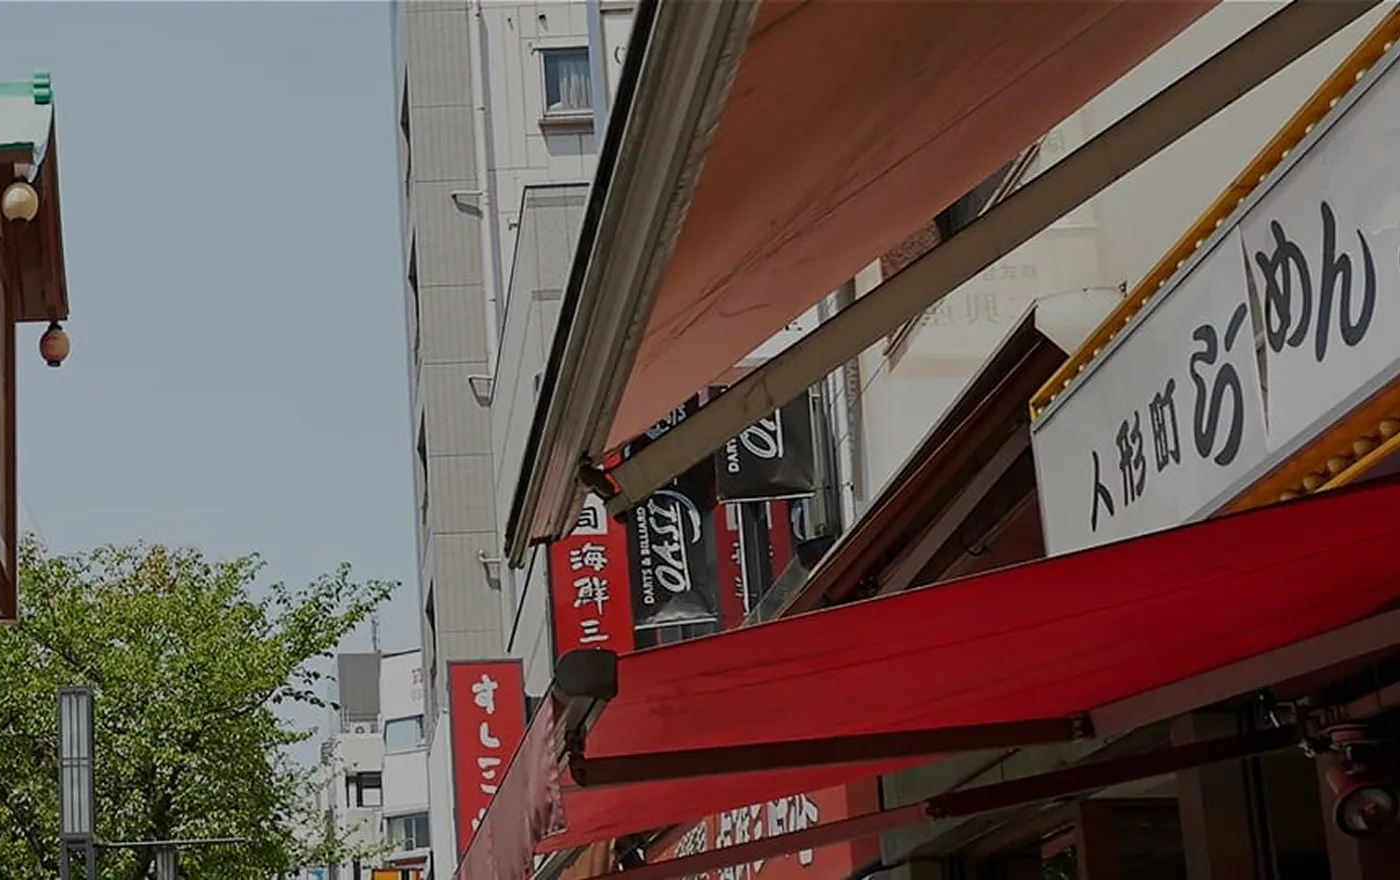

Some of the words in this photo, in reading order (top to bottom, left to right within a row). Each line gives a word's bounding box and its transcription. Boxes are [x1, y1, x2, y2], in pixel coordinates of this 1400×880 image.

[1091, 377, 1181, 533] 人形町
[636, 506, 650, 555] BILLIARD
[570, 542, 609, 648] 海鮮三
[641, 569, 655, 604] DARTS
[471, 674, 501, 832] すし三
